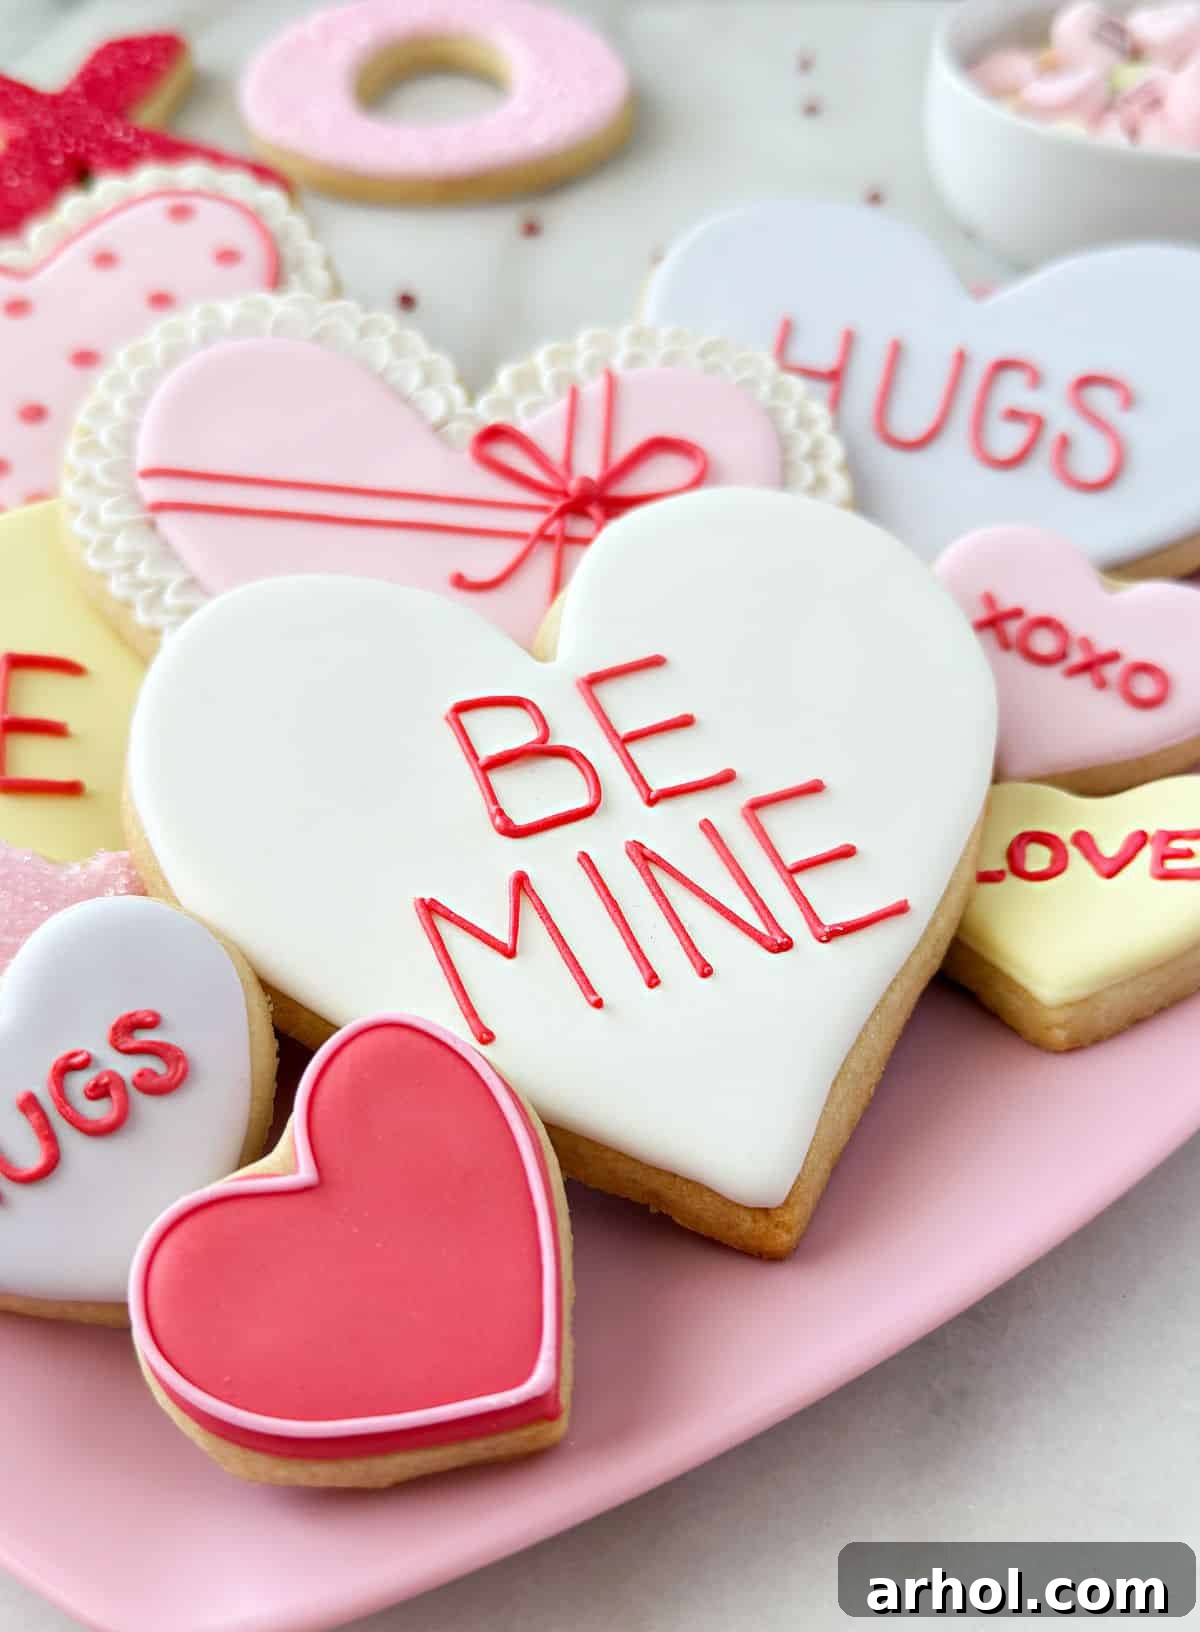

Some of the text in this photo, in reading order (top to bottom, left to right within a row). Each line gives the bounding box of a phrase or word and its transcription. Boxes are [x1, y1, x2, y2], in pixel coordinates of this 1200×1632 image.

[773, 312, 1136, 494] HUGS
[971, 590, 1174, 713] XOXO
[444, 653, 738, 840] BE
[414, 777, 912, 1046] MINE
[974, 828, 1200, 885] OVE
[0, 1008, 190, 1208] UGS
